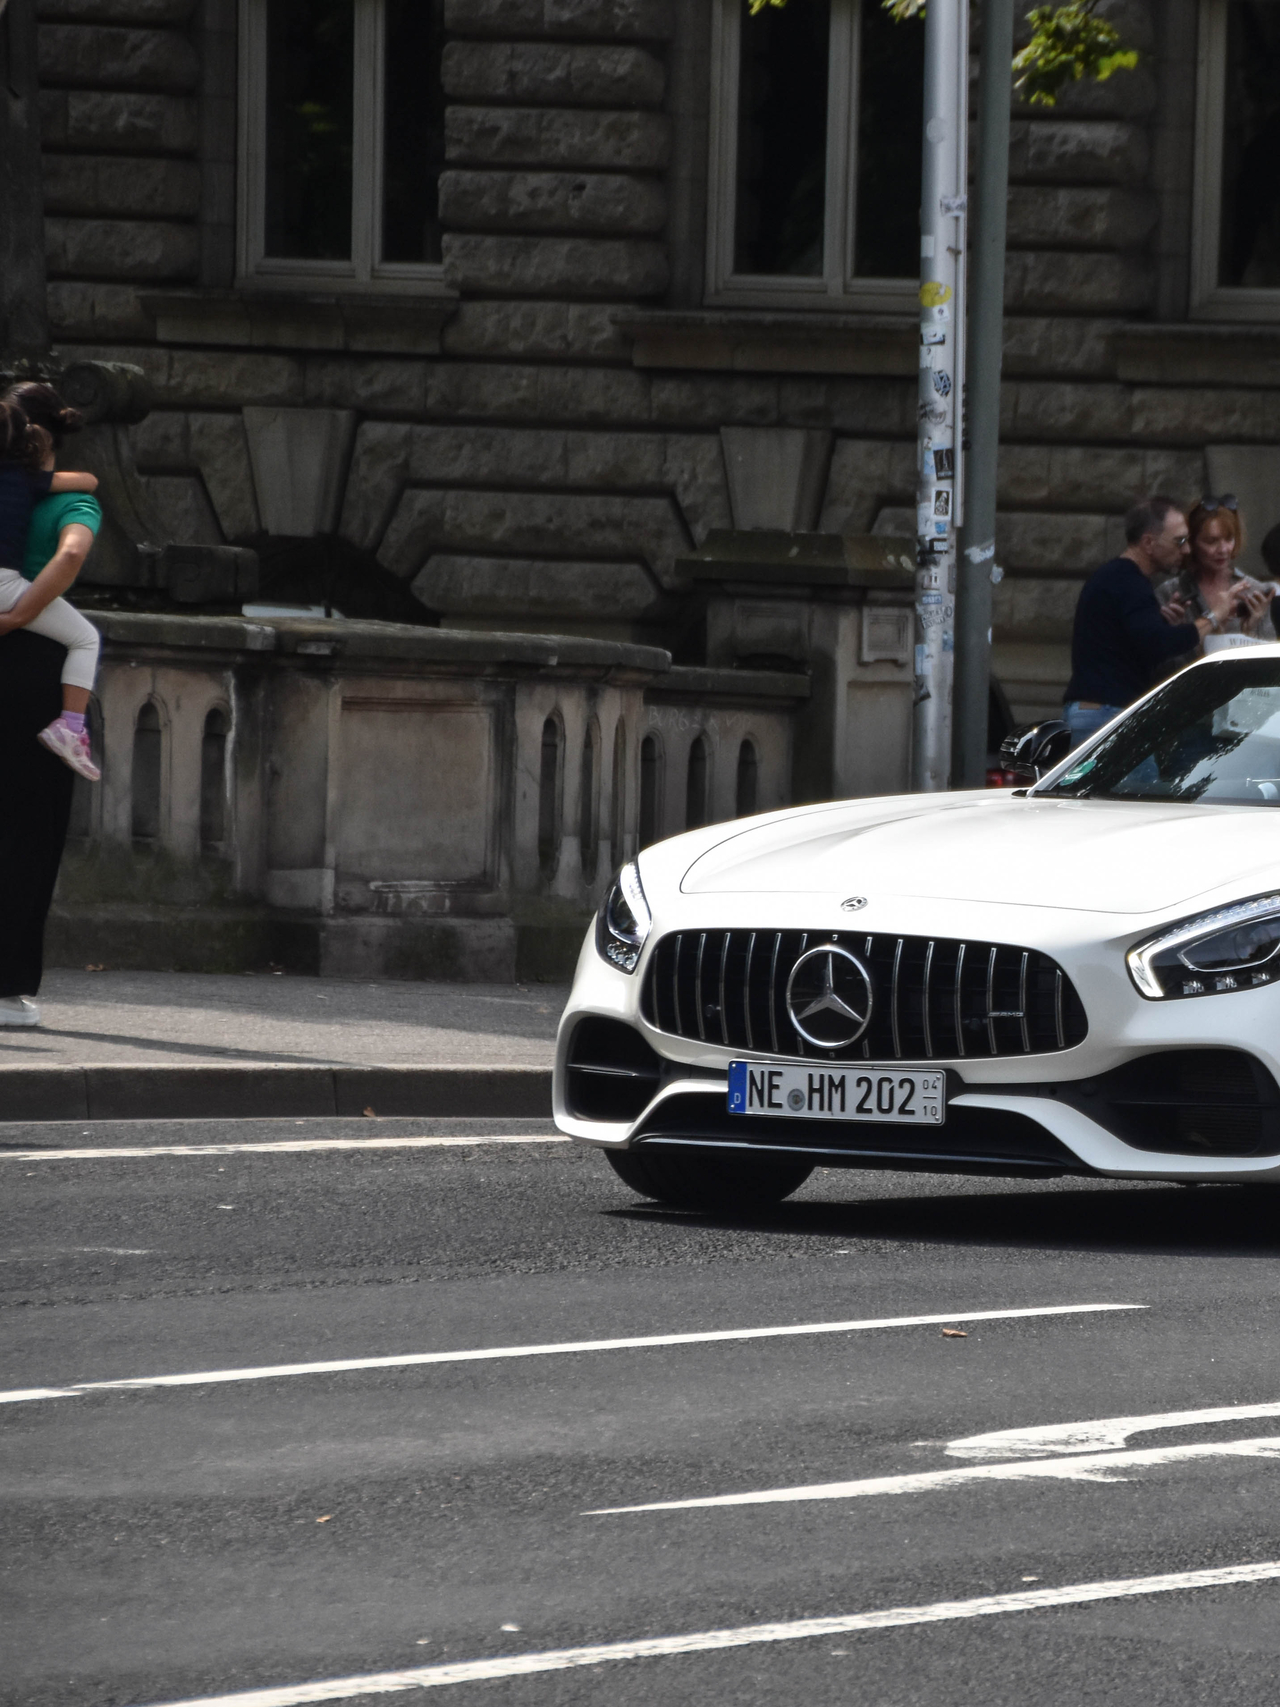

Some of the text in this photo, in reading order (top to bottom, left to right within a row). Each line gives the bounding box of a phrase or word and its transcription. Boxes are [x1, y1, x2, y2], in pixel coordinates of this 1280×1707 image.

[922, 1079, 938, 1090] 04
[734, 1092, 742, 1104] D
[749, 1069, 917, 1116] NE HM 202
[922, 1105, 938, 1117] 10
